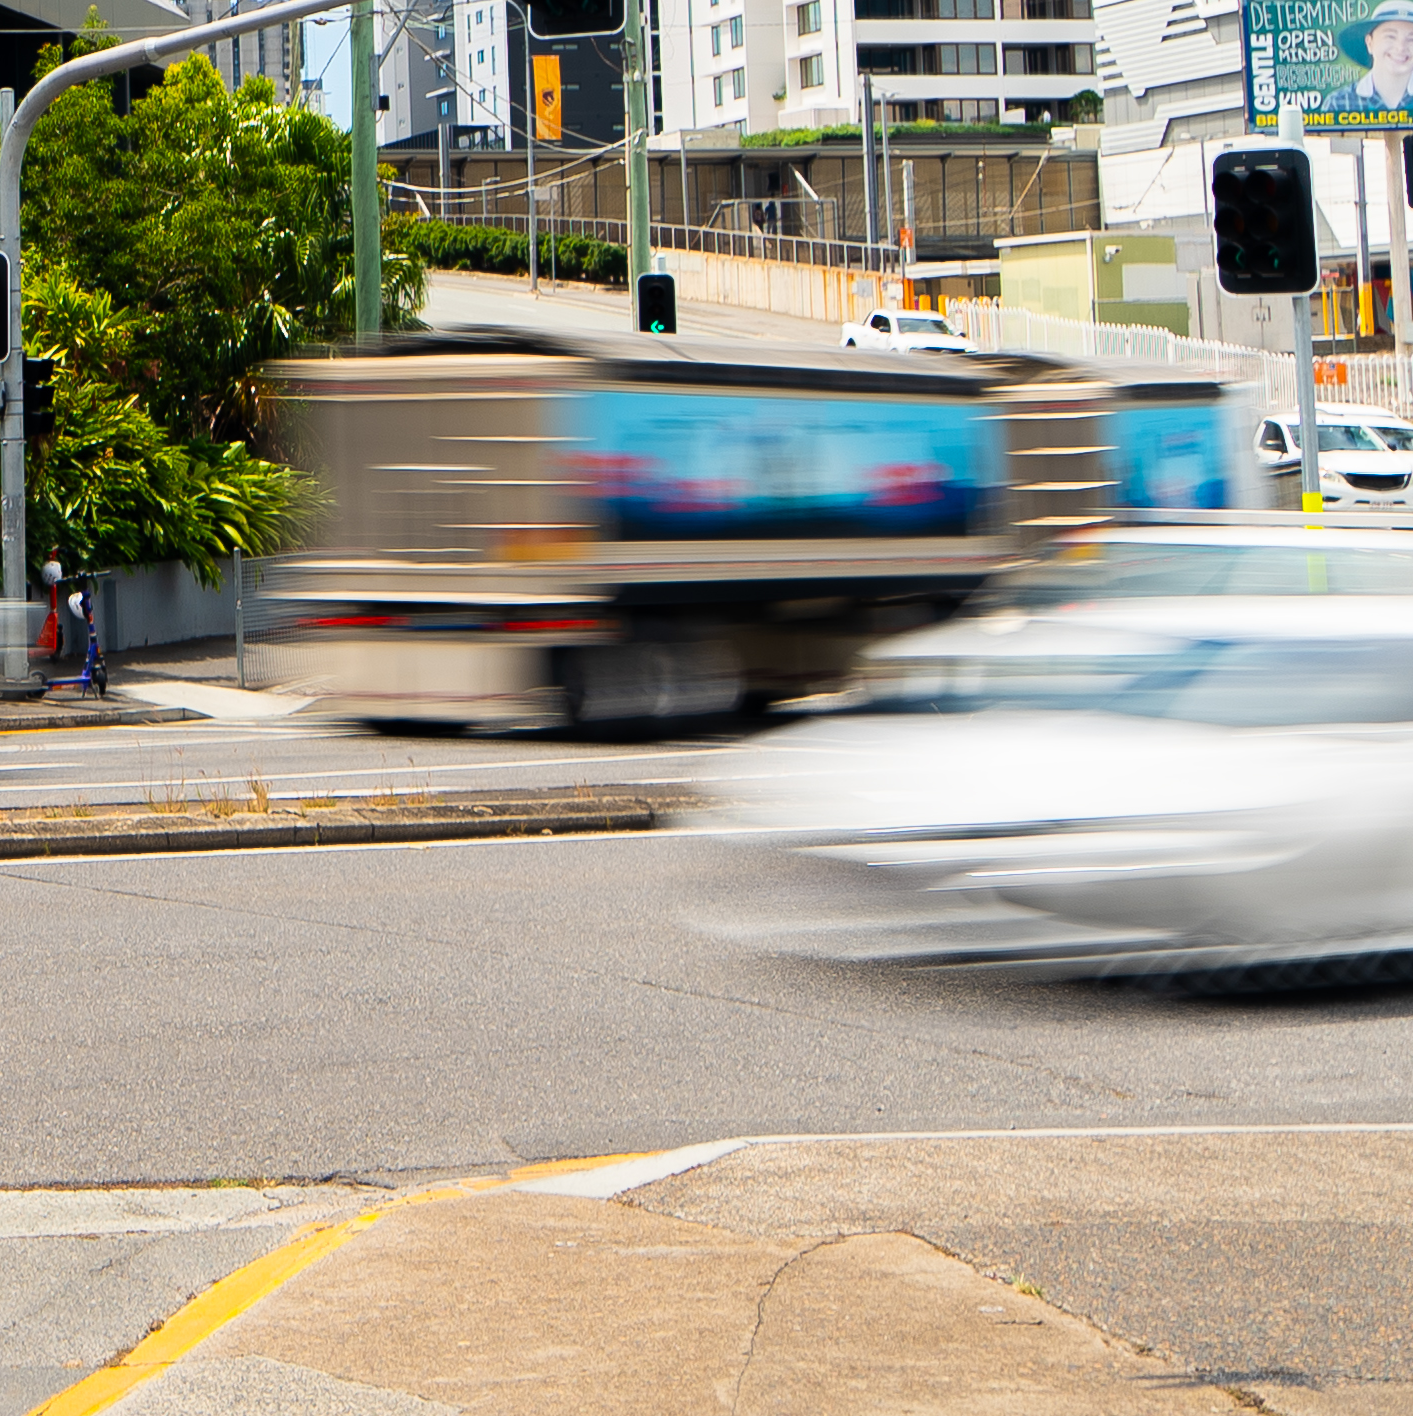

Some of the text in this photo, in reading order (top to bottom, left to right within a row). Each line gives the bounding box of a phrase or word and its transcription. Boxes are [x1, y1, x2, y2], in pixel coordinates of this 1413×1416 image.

[1277, 29, 1334, 50] OPEN
[1278, 46, 1338, 63] MINDED
[1250, 33, 1276, 112] GENTLE
[1279, 90, 1322, 111] KIND
[1338, 110, 1412, 125] COLLEGE,
